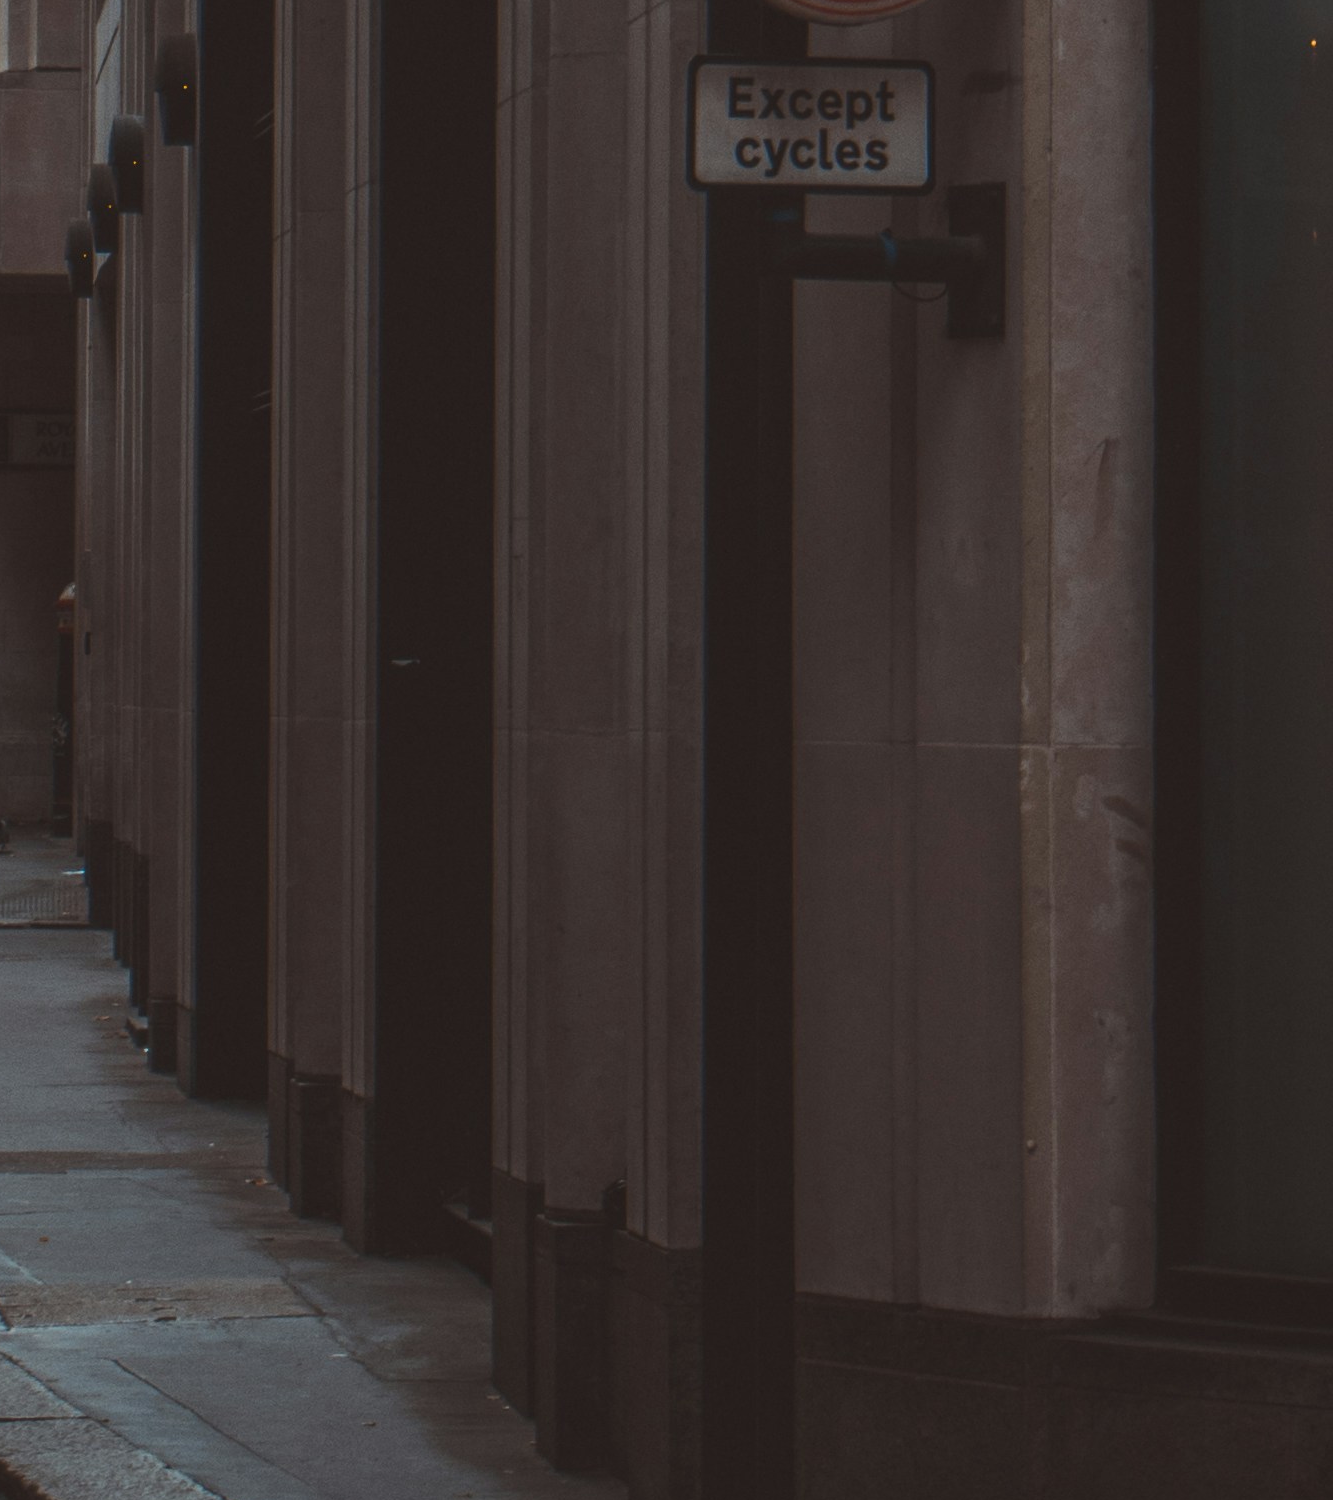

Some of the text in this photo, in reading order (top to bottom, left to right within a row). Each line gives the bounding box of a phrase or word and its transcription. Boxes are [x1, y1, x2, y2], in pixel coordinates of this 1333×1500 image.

[728, 76, 896, 130] Except
[734, 128, 889, 178] cycles
[36, 420, 76, 437] ROY
[36, 440, 76, 458] AVE
